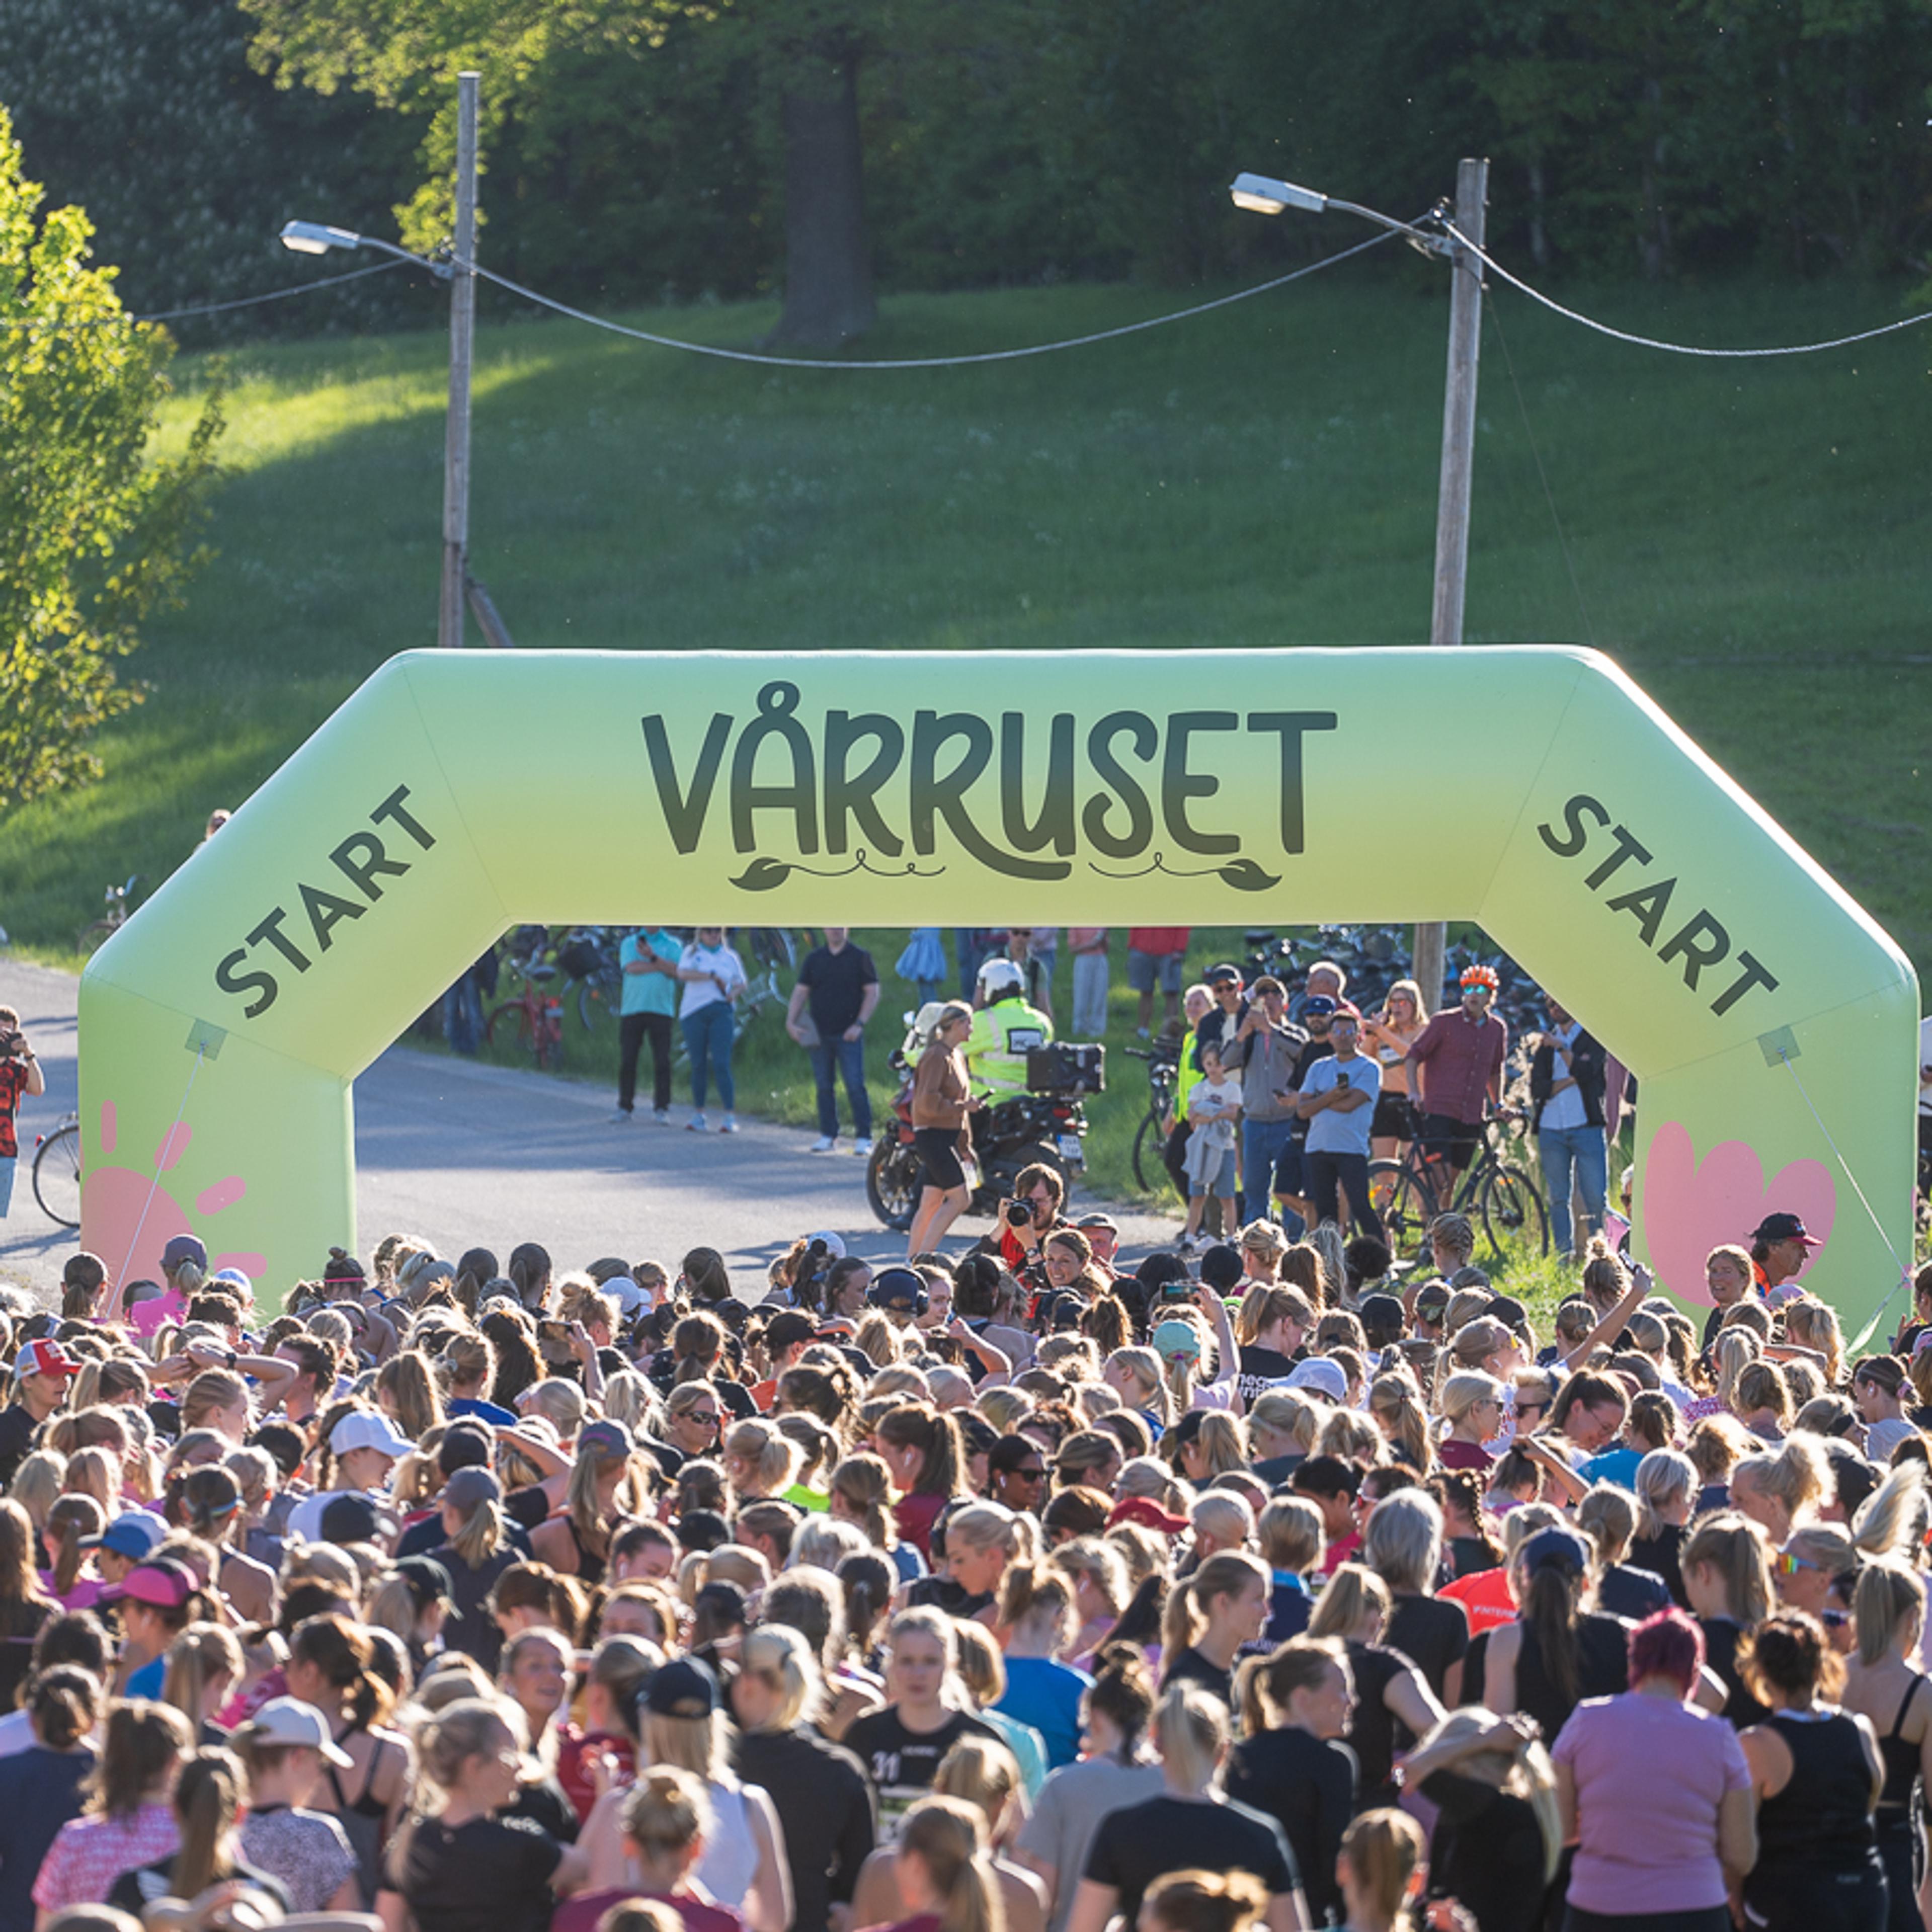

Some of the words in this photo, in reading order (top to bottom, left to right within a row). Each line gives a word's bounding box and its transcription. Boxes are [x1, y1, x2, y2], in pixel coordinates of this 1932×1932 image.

[641, 681, 1338, 880] VÅRRUSET
[216, 784, 437, 1019] START
[1537, 794, 1780, 1017] START
